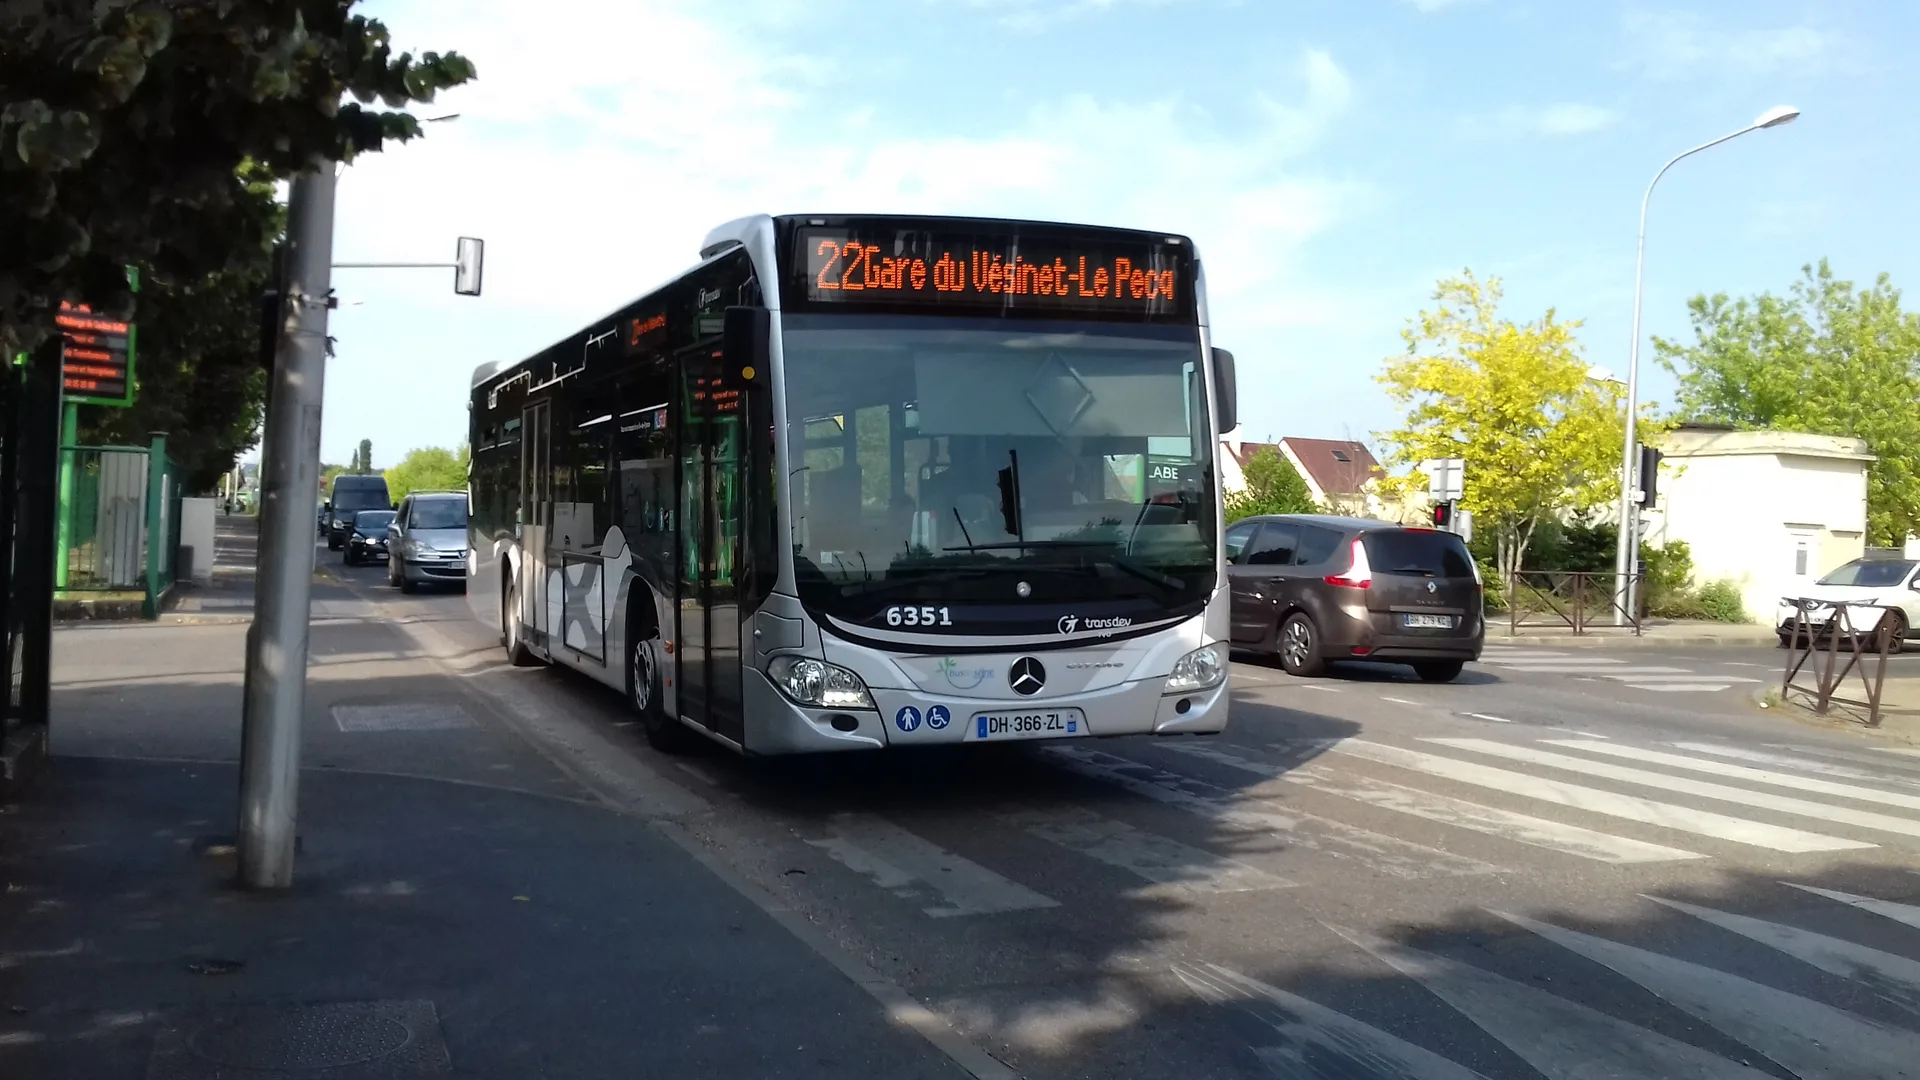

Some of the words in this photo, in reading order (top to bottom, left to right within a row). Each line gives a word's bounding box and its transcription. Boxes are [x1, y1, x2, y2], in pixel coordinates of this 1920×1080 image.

[864, 245, 927, 290] Gare
[933, 252, 965, 292] du
[972, 251, 1109, 298] Vésinet-Le
[1115, 256, 1174, 300] Pecq
[886, 606, 953, 626] 6351
[1084, 616, 1132, 629] transdev
